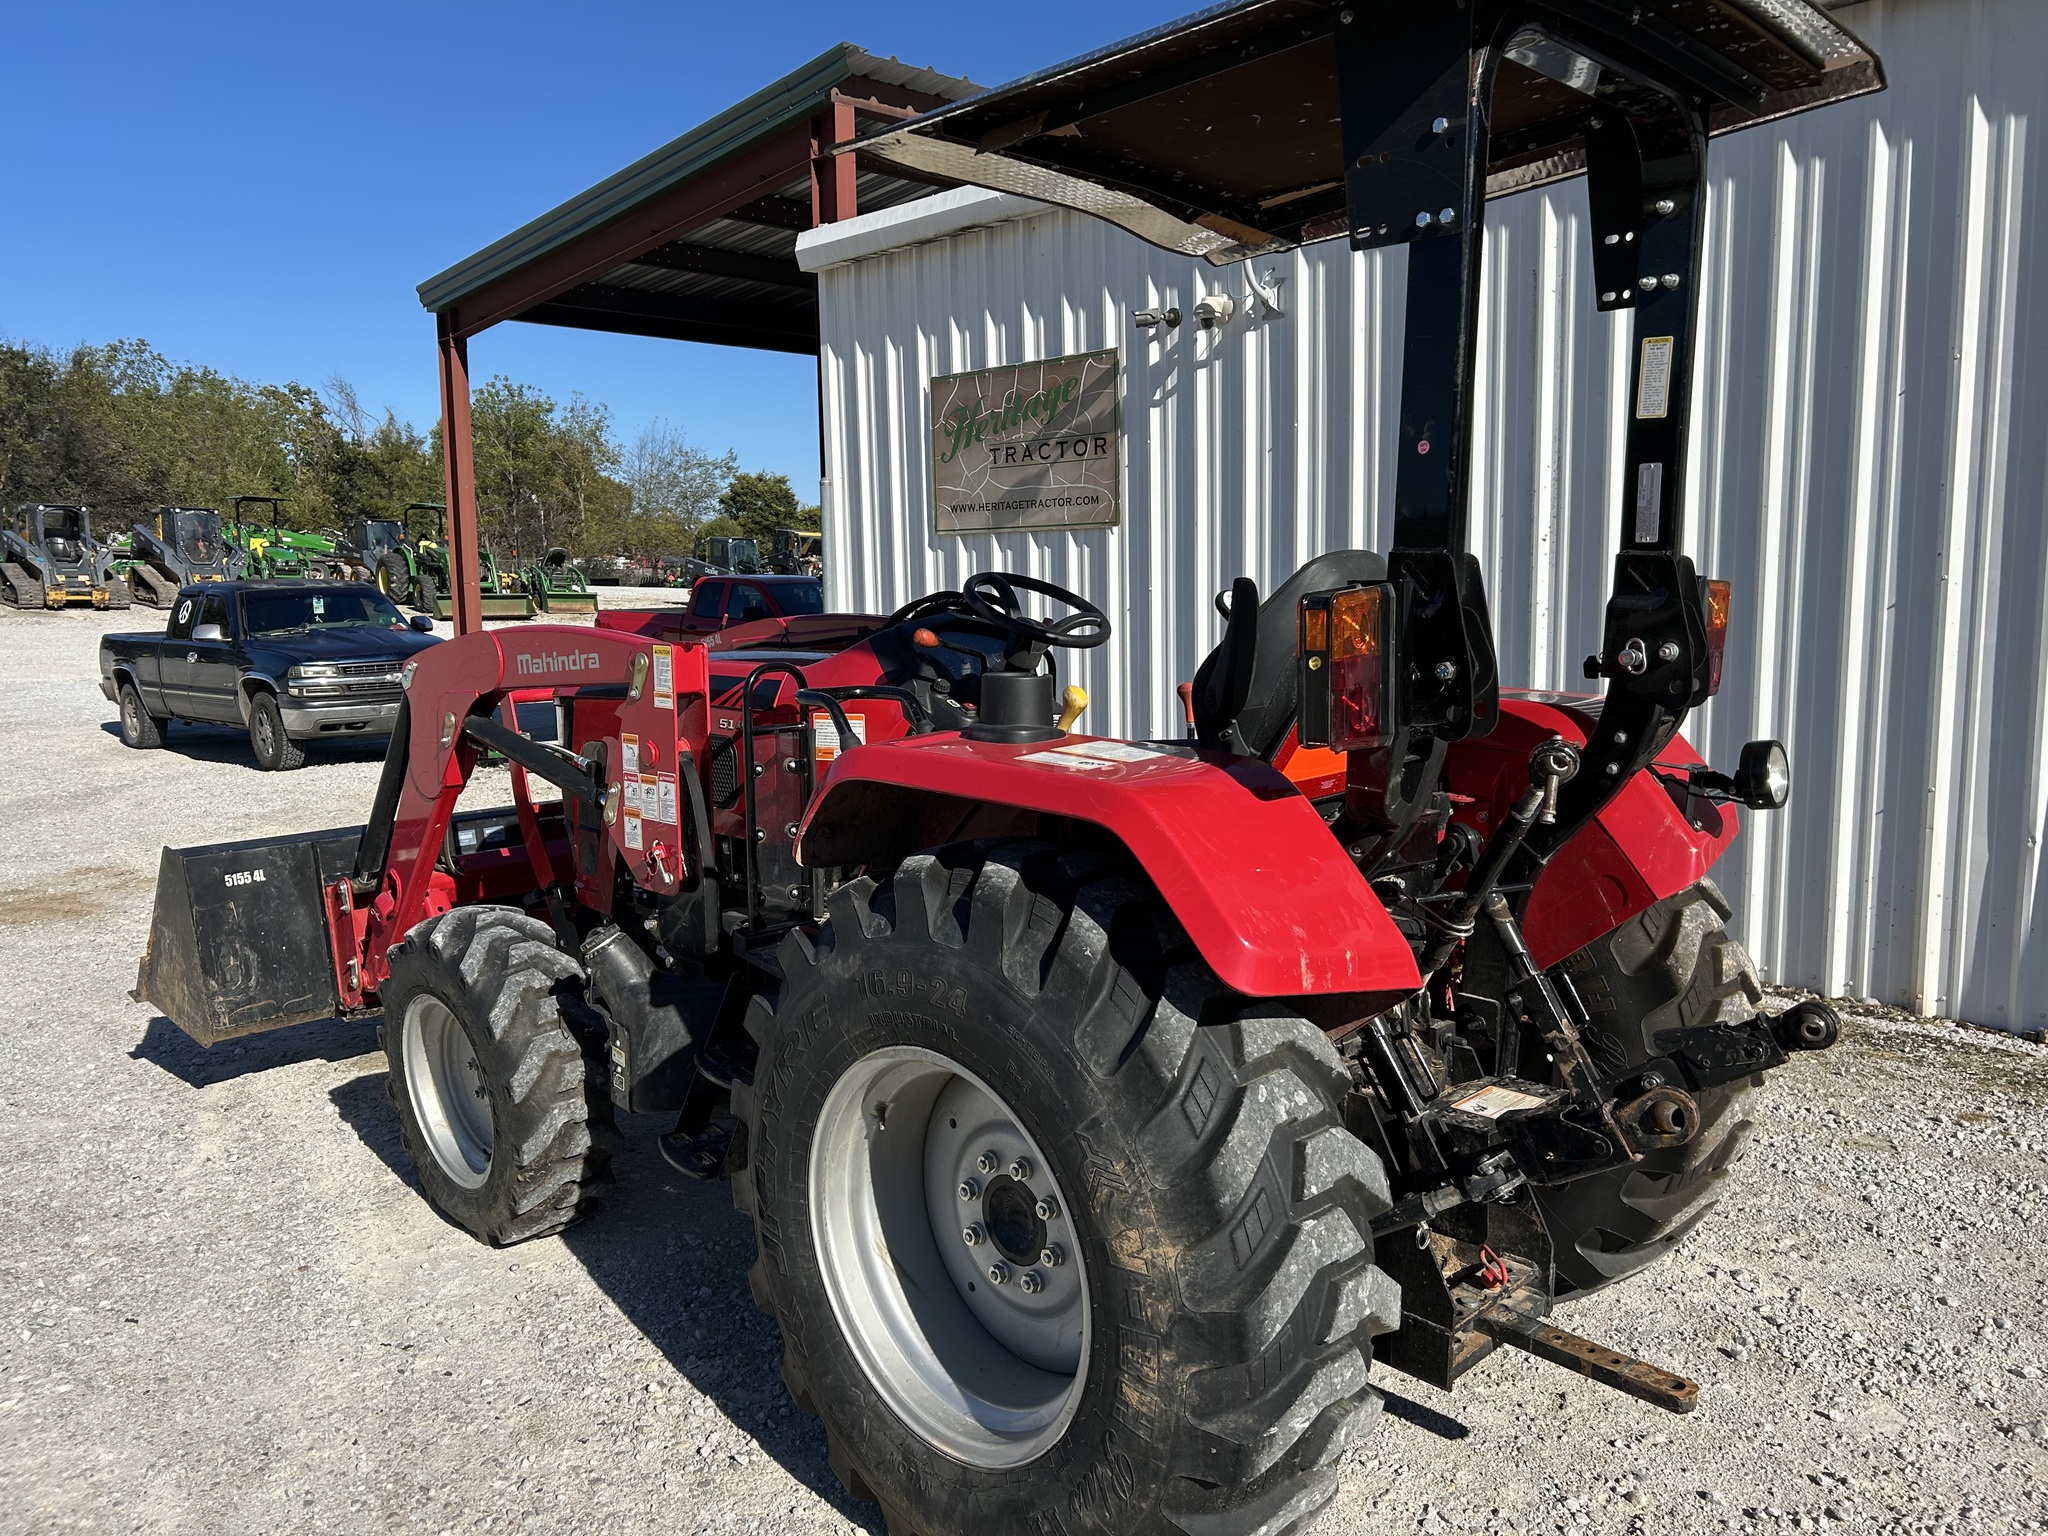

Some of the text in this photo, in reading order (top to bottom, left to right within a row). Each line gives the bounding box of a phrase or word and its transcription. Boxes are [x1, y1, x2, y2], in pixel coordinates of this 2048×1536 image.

[941, 377, 1079, 464] Heritage
[989, 436, 1108, 465] TRACTOR
[950, 495, 1100, 514] WWW.HERITAGETRACTOR.COM
[516, 648, 600, 675] Mahindra
[224, 869, 267, 887] 5155 4L
[853, 967, 968, 1020] 16.9-24
[867, 1010, 960, 1045] INDUSTRIAL
